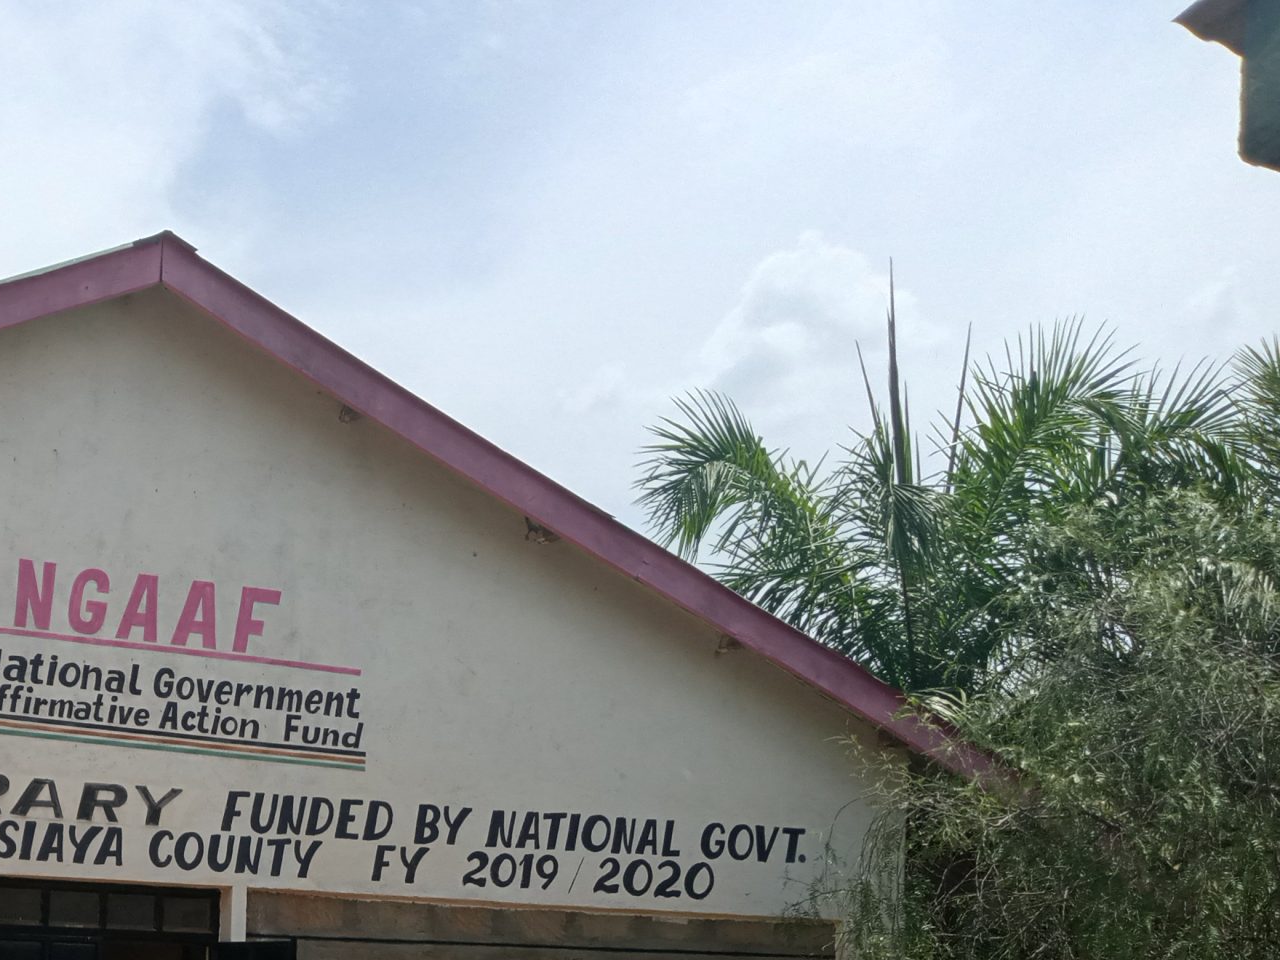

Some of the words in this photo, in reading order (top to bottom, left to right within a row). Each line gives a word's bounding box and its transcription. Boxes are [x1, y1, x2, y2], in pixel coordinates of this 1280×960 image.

[13, 558, 282, 653] NGAAF
[152, 667, 361, 719] Government
[159, 701, 260, 739] Action
[283, 714, 363, 749] Fund
[220, 790, 394, 841] FUNDED
[413, 803, 472, 846] BY
[485, 809, 681, 854] NATIONAL
[700, 822, 807, 865] GOVT.
[148, 830, 324, 879] COUNTY
[370, 844, 431, 884] FY
